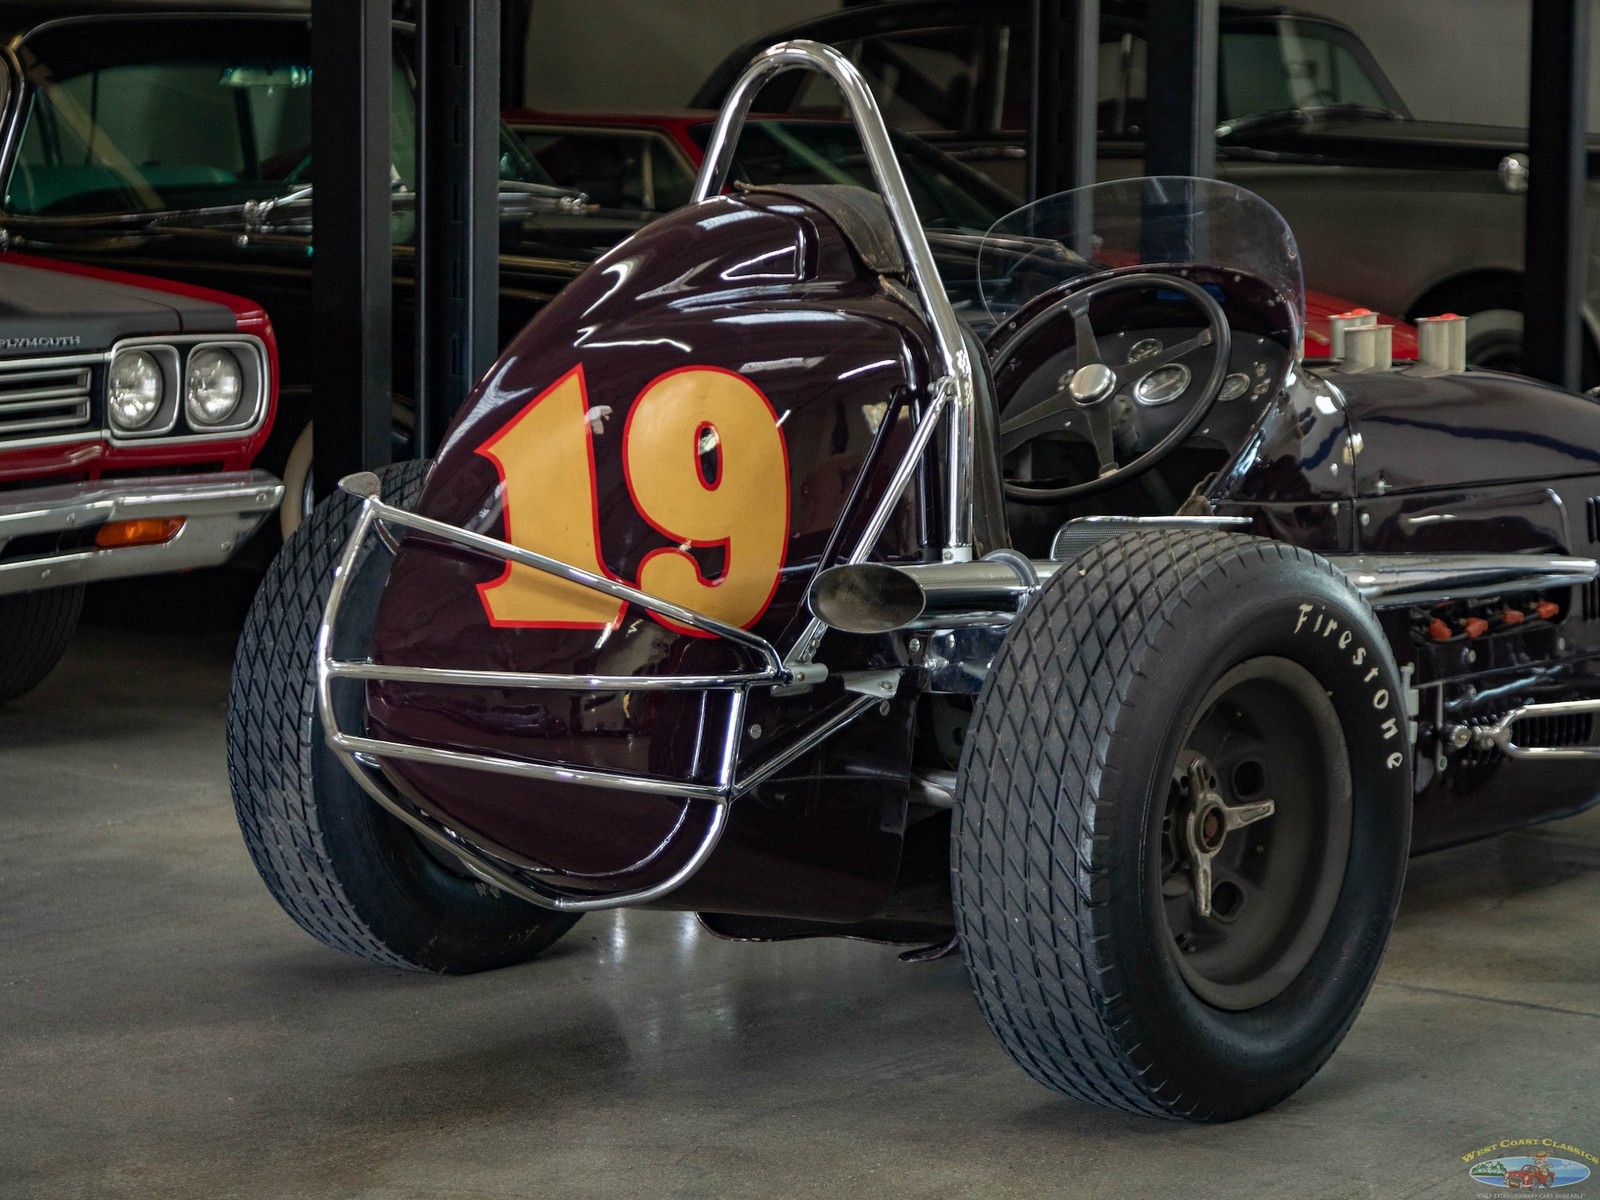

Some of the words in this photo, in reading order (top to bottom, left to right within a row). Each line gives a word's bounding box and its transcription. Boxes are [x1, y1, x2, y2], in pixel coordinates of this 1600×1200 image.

[0, 336, 81, 347] PLYMOUTH
[473, 361, 791, 638] 19
[1294, 604, 1403, 769] Firestone
